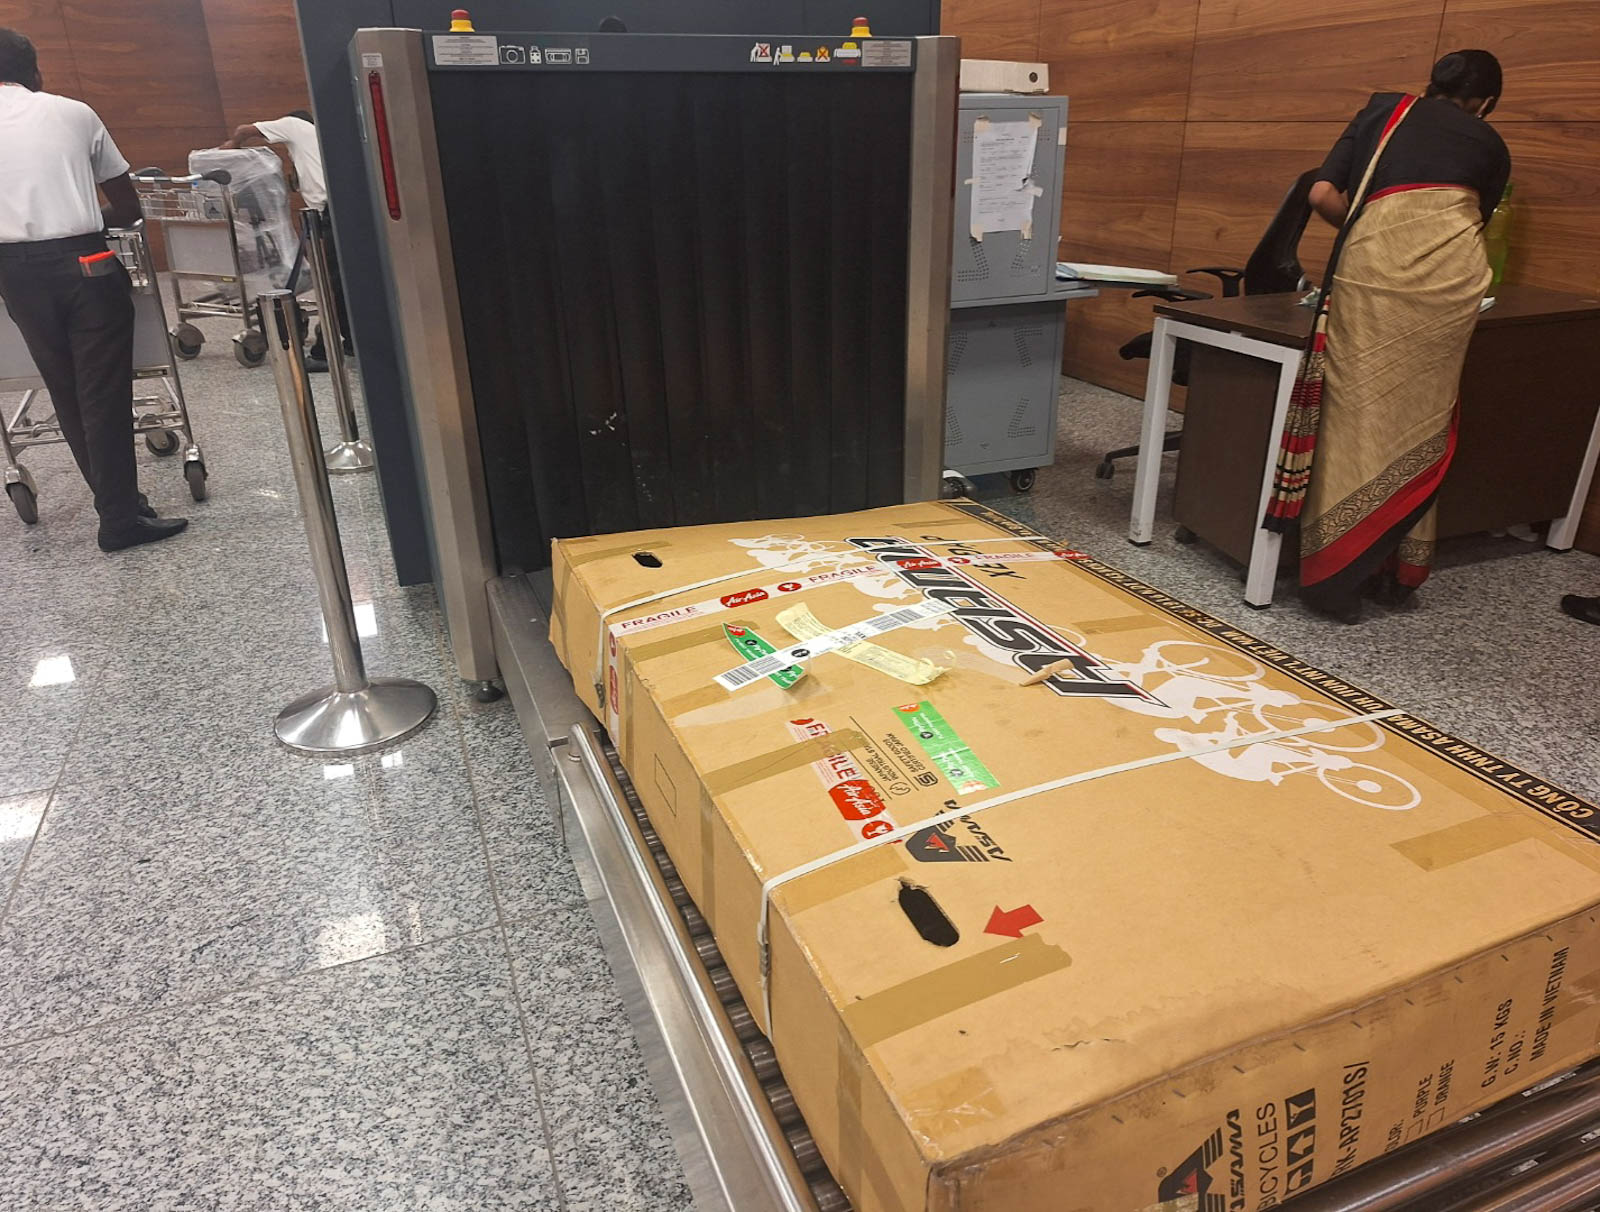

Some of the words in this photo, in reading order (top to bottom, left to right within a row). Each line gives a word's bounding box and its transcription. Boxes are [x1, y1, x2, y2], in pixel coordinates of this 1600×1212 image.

[808, 565, 875, 584] FRAGILE
[621, 606, 698, 630] FRAGILE
[1386, 713, 1452, 745] ASAMA
[898, 754, 920, 773] SAFETY
[1444, 744, 1501, 774] TNHH
[1495, 773, 1533, 789] TY
[1526, 786, 1595, 819] CÔNG
[1542, 946, 1570, 1007] VIETNAM
[1493, 998, 1513, 1031] KGS
[1538, 1006, 1556, 1024] IN
[1489, 1031, 1506, 1051] 15
[1529, 1021, 1552, 1062] MADE
[1412, 1073, 1433, 1119] PURPLE
[1434, 1059, 1455, 1106] ORANGE
[1256, 1101, 1279, 1212] BICYCLES
